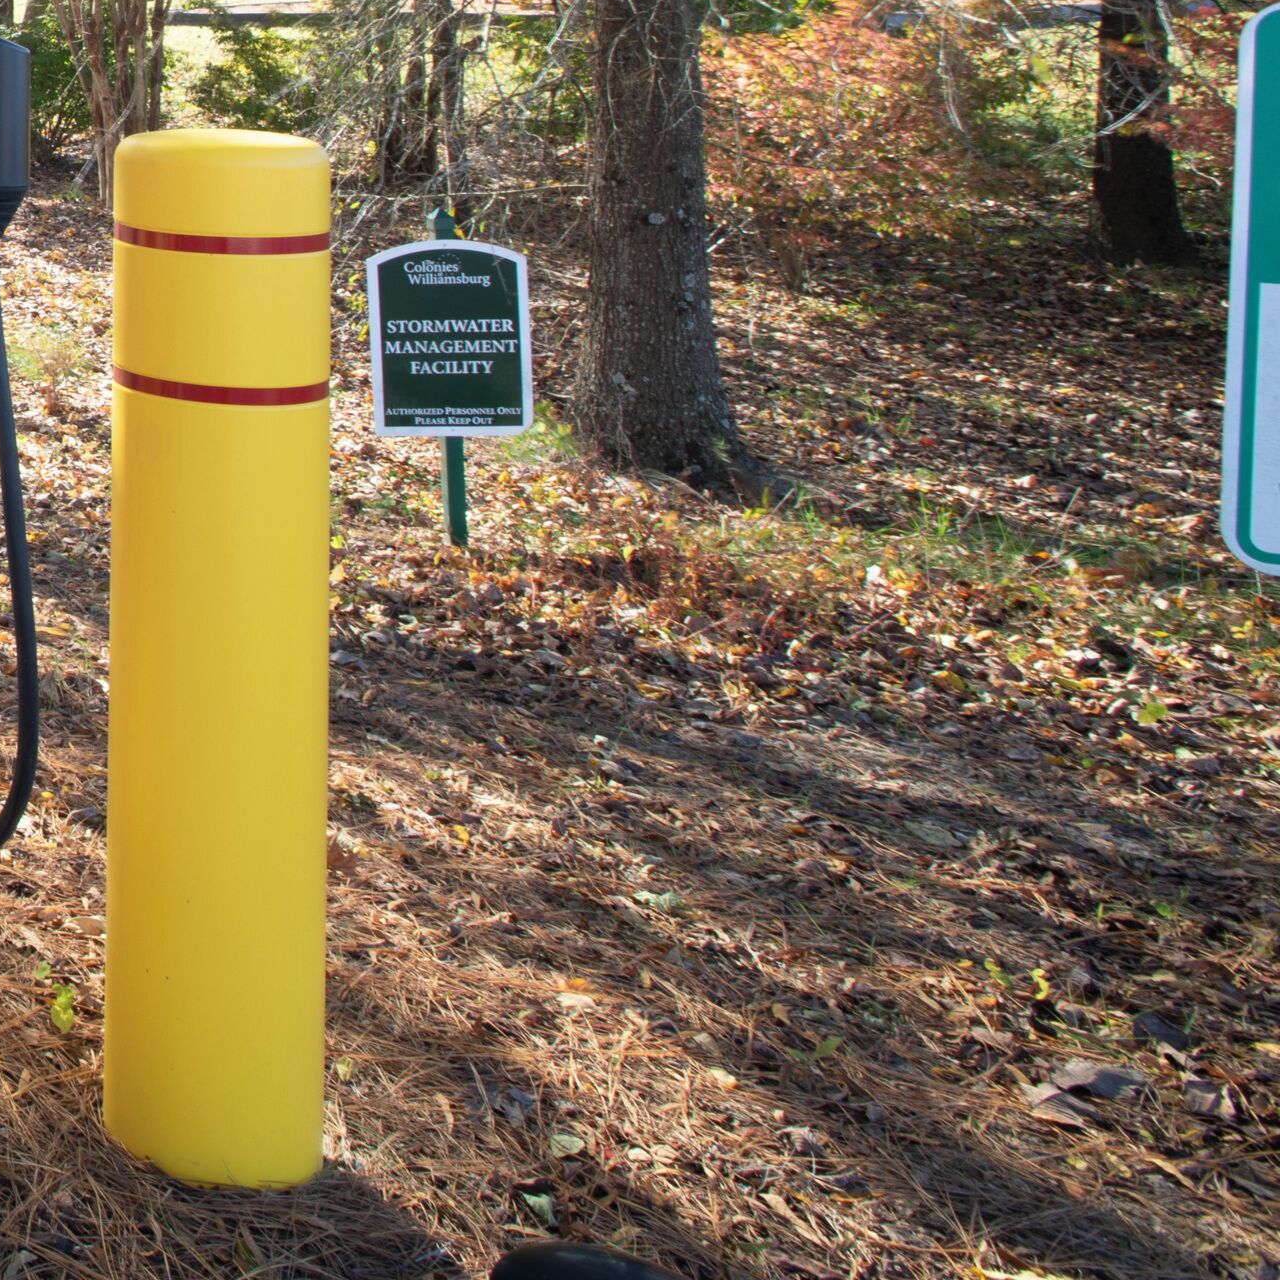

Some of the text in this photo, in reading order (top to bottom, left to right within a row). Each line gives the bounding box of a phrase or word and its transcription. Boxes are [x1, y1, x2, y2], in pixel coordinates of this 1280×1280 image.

[403, 261, 459, 273] Colonies
[407, 273, 491, 287] Williamsburg
[386, 319, 514, 333] STORMWATER
[385, 339, 518, 354] MANAGEMENT
[410, 361, 493, 374] FACILITY
